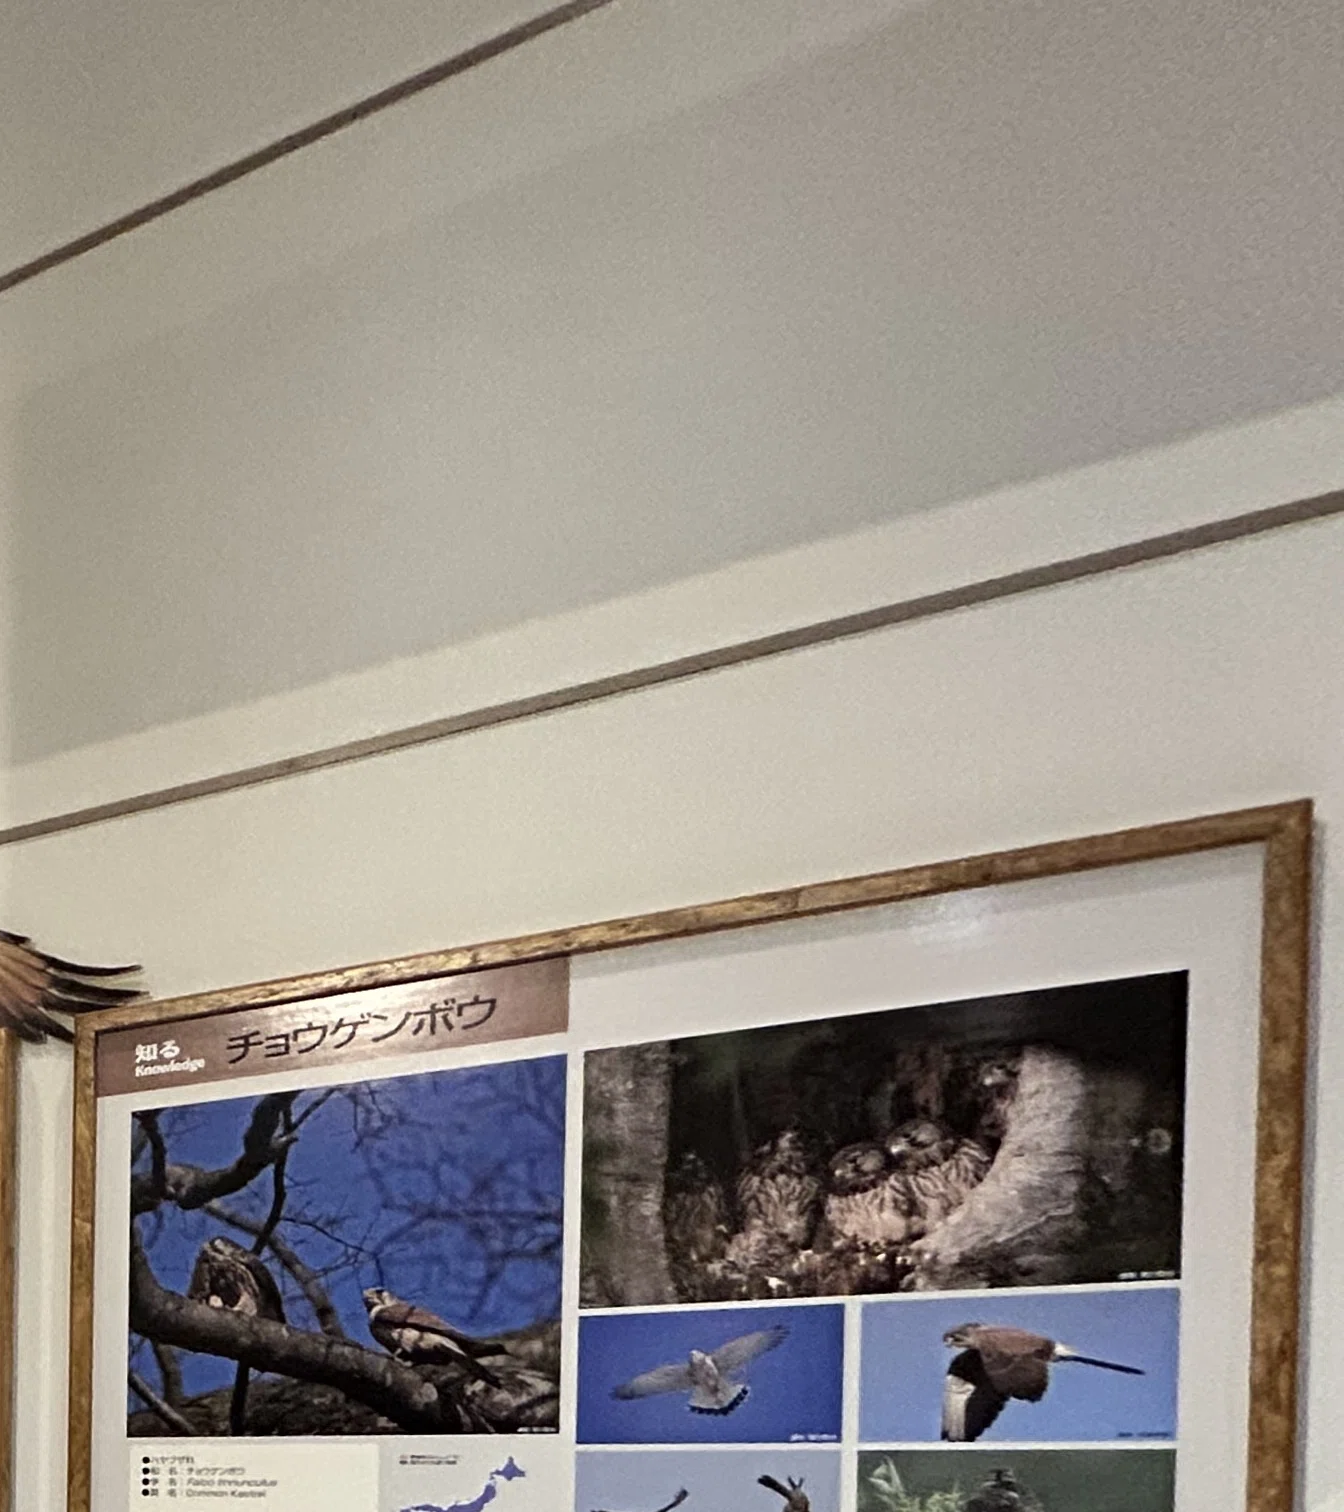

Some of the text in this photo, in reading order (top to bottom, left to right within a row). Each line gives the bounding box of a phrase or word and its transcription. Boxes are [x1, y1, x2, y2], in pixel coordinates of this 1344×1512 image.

[226, 994, 497, 1064] チョウゲンボウ
[135, 1039, 180, 1063] 知る
[135, 1056, 206, 1078] Knowledge
